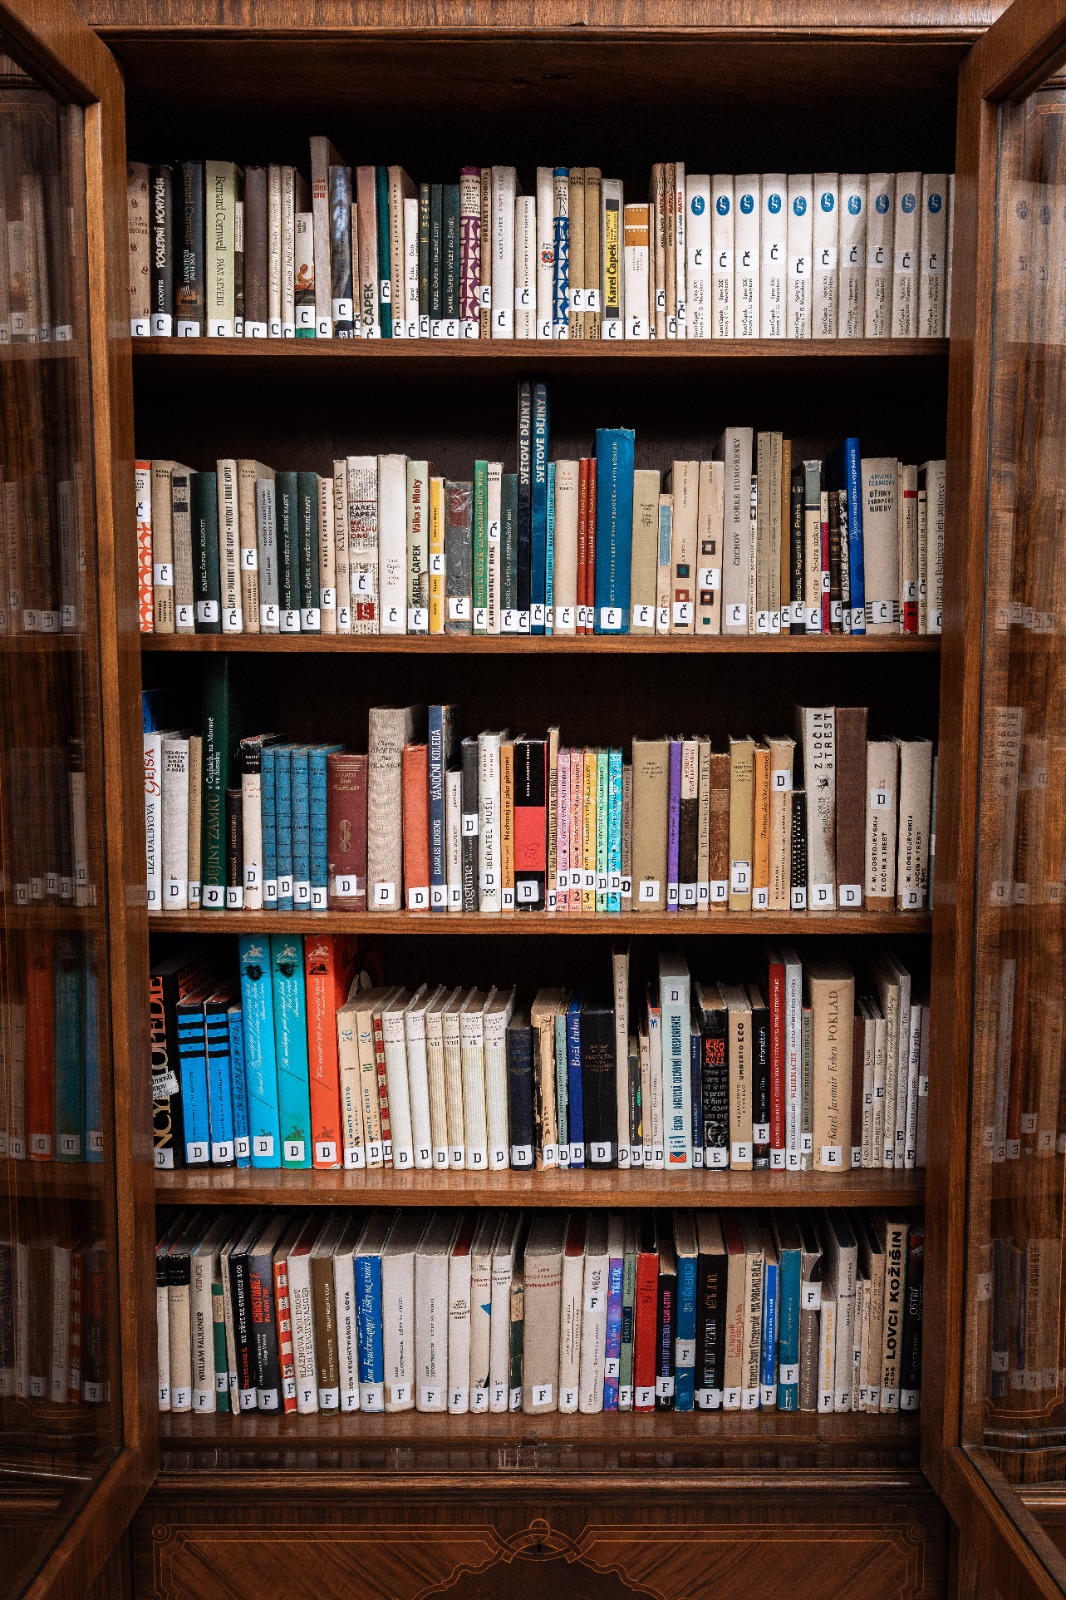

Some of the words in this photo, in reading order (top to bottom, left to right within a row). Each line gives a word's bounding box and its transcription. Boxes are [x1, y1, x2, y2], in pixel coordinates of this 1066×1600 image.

[154, 177, 166, 224] MOHYKÁN
[216, 176, 226, 211] Bernard
[216, 213, 226, 251] Cornwell
[154, 227, 166, 268] POSLEDNÍ
[694, 249, 702, 265] Č
[875, 247, 884, 264] Č
[606, 244, 618, 275] Čapek
[796, 258, 804, 274] Č
[521, 288, 529, 304] Č
[608, 276, 616, 304] Karel
[363, 284, 374, 328] ČAPEK
[608, 322, 616, 338] Č
[520, 398, 530, 436] DĚJINY
[535, 398, 546, 434] DĚJINY
[520, 440, 530, 485] SVĚTOVÉ
[536, 438, 545, 483] SVĚTOVÉ
[412, 479, 422, 504] Mloky
[936, 483, 944, 517] autorce
[225, 506, 234, 526] POVÍDKY
[412, 511, 421, 533] Válka
[337, 515, 345, 552] KAREL
[489, 522, 498, 538] Č
[410, 545, 420, 573] ČAPEK
[732, 532, 740, 566] ČECHOV
[795, 540, 803, 575] Paganini
[934, 542, 943, 576] Babičce
[412, 574, 420, 604] KAREL
[179, 607, 187, 622] Č
[266, 606, 274, 621] Č
[339, 608, 347, 624] Č
[414, 610, 421, 625] Č
[534, 605, 542, 621] Č
[680, 604, 687, 619] Č
[781, 608, 789, 623] Č
[431, 729, 442, 760] KOLEDA
[812, 713, 823, 769] ZLOČIN
[824, 713, 832, 759] TREST
[208, 744, 214, 752] na
[431, 764, 442, 800] VÁNOČNÍ
[207, 794, 220, 840] ZÁMKŮ
[146, 803, 155, 853] DALBYOVÁ
[433, 847, 441, 875] CHARLES
[246, 871, 256, 883] D
[559, 875, 568, 887] D
[872, 874, 878, 883] M.
[312, 892, 322, 904] D
[434, 891, 442, 903] D
[573, 891, 580, 902] 2
[584, 893, 590, 902] 3
[646, 886, 654, 897] D
[716, 886, 725, 897] D
[818, 889, 827, 901] D
[829, 990, 838, 1041] POKLAD
[571, 1019, 580, 1043] duha
[571, 1046, 580, 1066] Boží
[828, 1046, 838, 1072] Erben
[828, 1076, 838, 1112] Jaromír
[828, 1115, 837, 1140] Karel
[219, 1146, 228, 1158] D
[574, 1148, 582, 1159] D
[738, 1147, 746, 1158] E
[804, 1138, 811, 1149] E
[350, 1152, 359, 1163] D
[420, 1149, 429, 1160] D
[473, 1152, 482, 1163] D
[631, 1150, 641, 1161] D
[888, 1232, 902, 1303] KOŽIŠIN
[251, 1280, 263, 1323] CHRISTIANE
[807, 1292, 815, 1303] F
[294, 1288, 303, 1333] MOUDROST
[302, 1287, 312, 1354] FEUCHTWANGER
[886, 1310, 898, 1360] LOVCI
[297, 1336, 306, 1378] BLÁZNOVA
[748, 1365, 758, 1389] Francis
[198, 1395, 206, 1406] F
[324, 1394, 332, 1405] F
[427, 1391, 435, 1402] F
[566, 1393, 573, 1404] F
[642, 1391, 650, 1402] F
[729, 1392, 736, 1403] F
